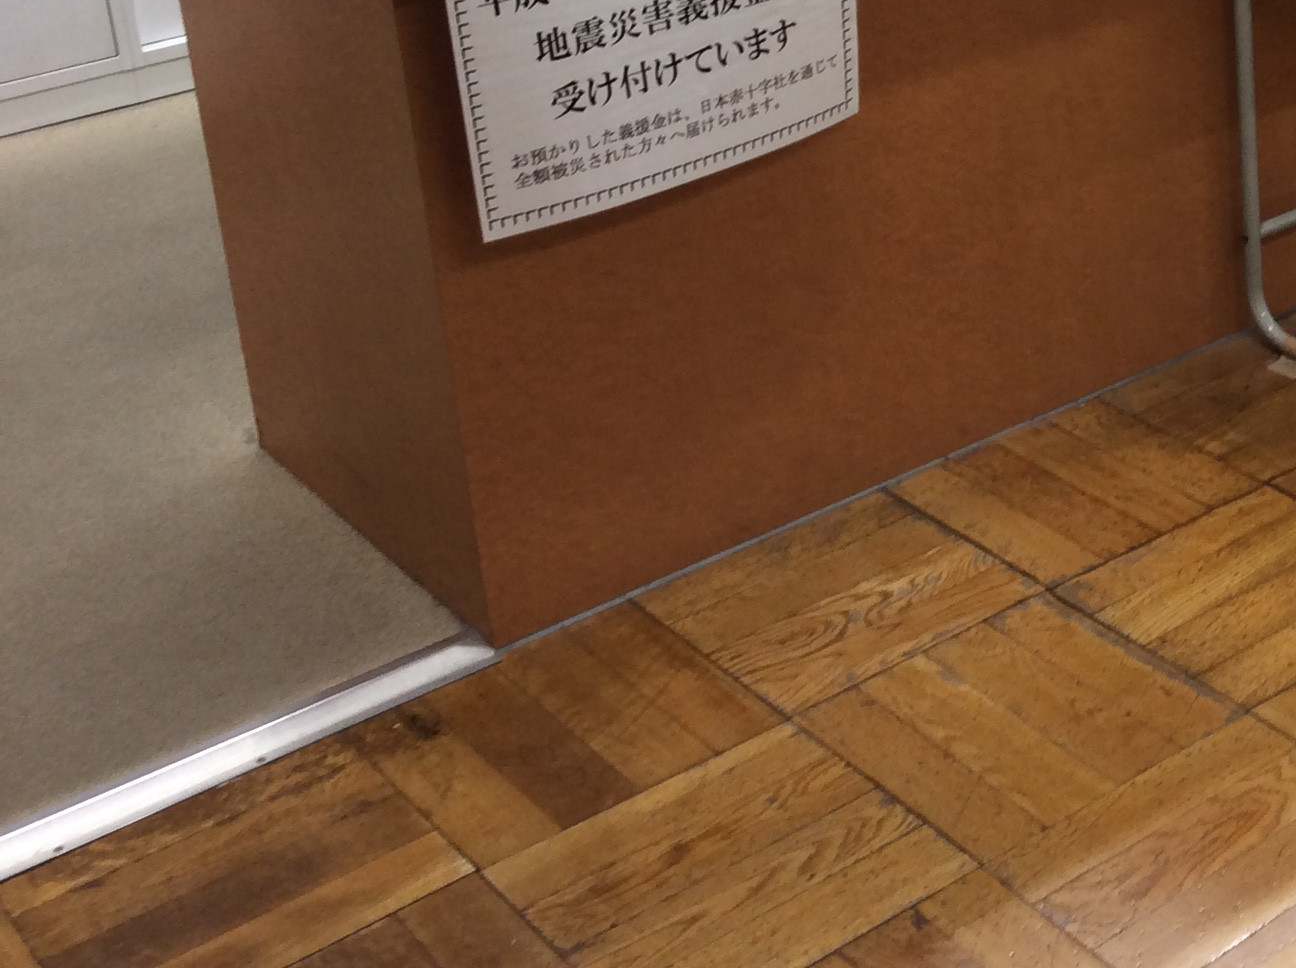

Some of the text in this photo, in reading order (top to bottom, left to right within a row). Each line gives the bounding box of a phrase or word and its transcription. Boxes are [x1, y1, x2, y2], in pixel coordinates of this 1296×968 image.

[512, 54, 839, 169] お預かりした義援金は、日本赤十字社を通じて
[551, 19, 797, 120] 受け付けています
[514, 102, 780, 190] 全額被災された方々へ届けられます。
